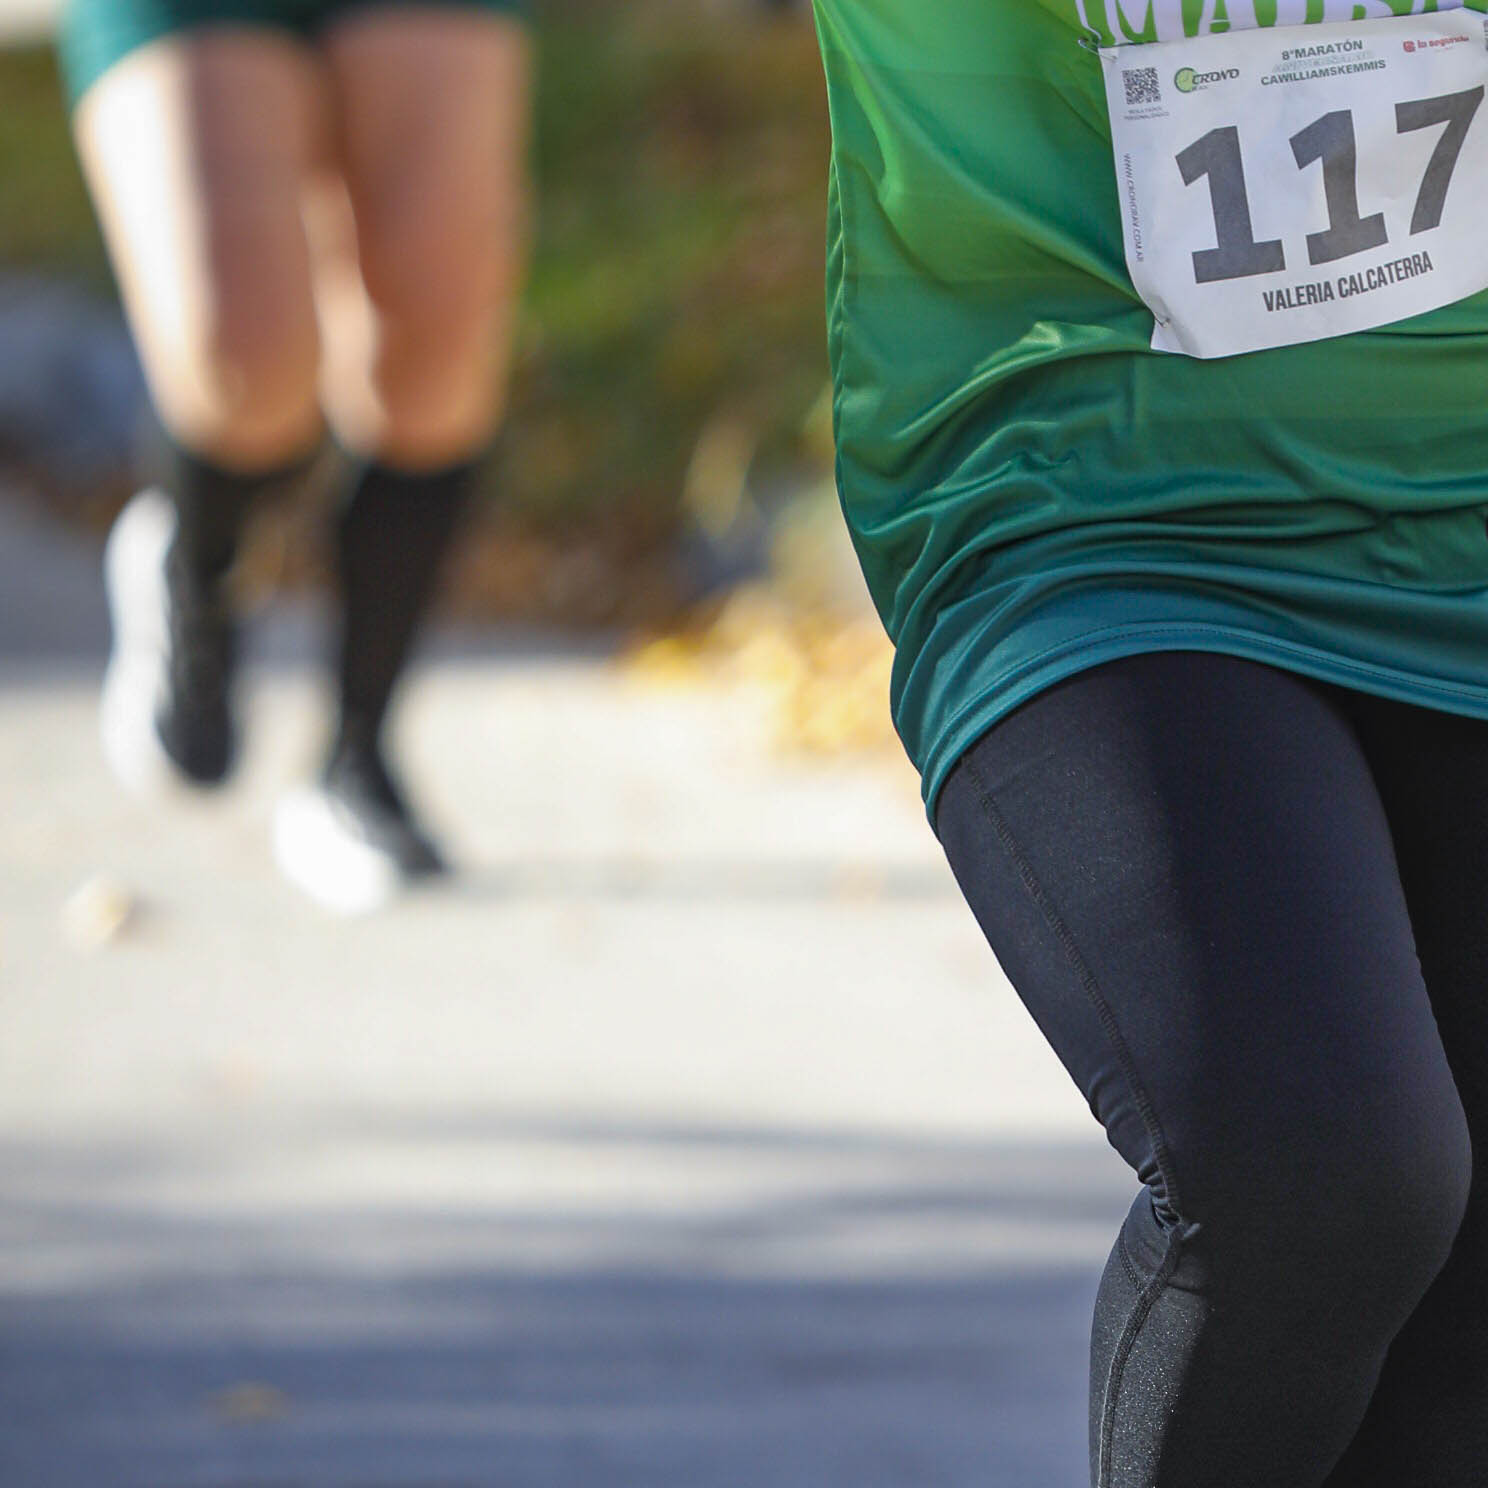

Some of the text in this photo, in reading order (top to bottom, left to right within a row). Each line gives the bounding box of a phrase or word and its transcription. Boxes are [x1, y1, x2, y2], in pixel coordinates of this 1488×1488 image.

[1260, 59, 1387, 86] CAWILLIAMSKEMMIS
[1175, 85, 1485, 284] 117
[1262, 250, 1434, 312] VALERIA CALCATERRA
